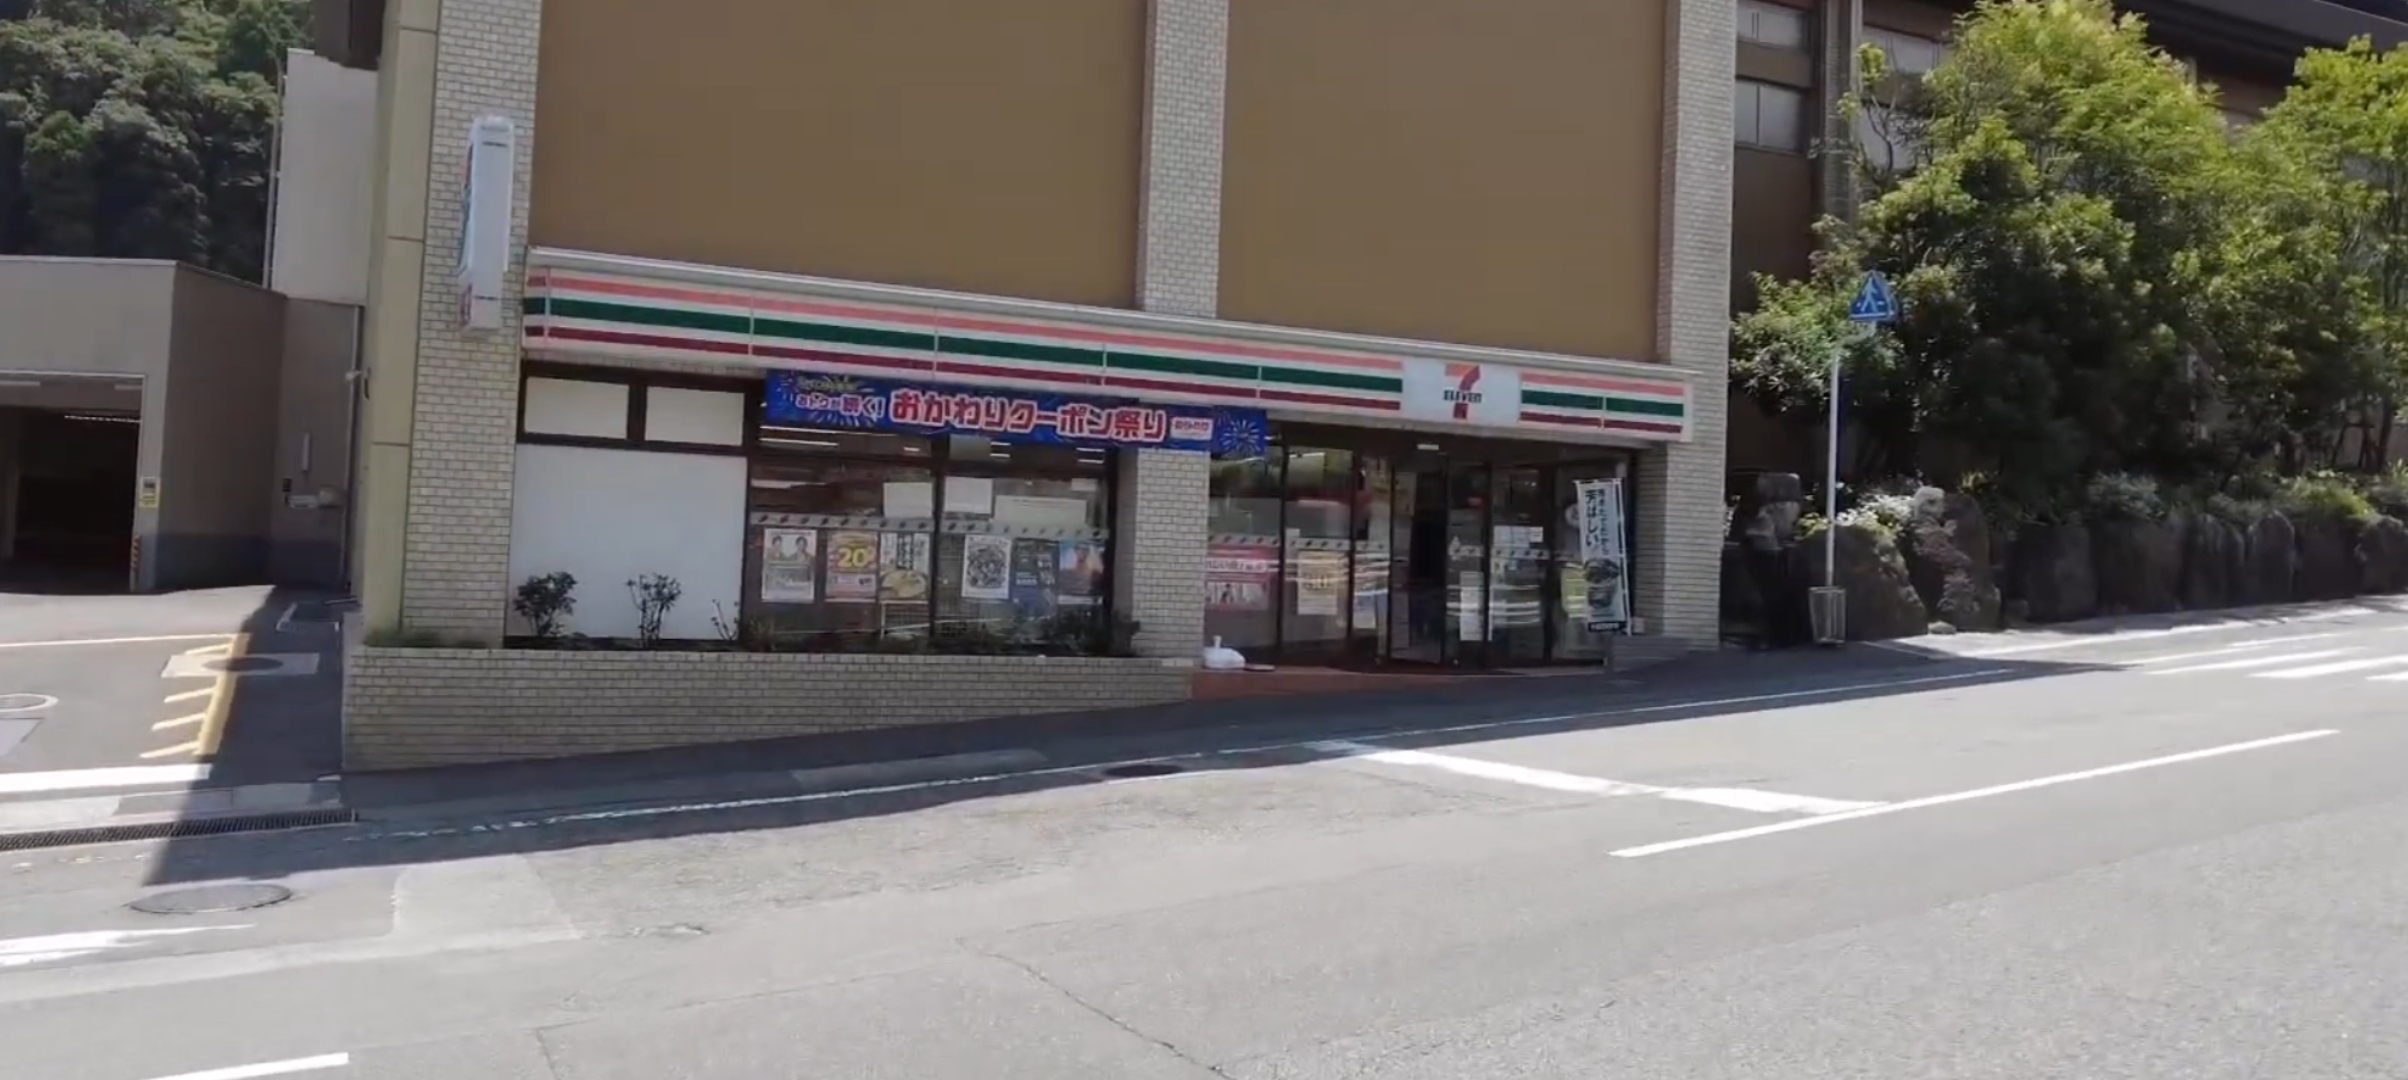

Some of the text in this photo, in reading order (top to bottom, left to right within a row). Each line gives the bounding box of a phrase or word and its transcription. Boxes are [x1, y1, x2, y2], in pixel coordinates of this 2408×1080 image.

[889, 389, 1167, 442] おかわりクーポン祭り
[1444, 363, 1481, 420] 7
